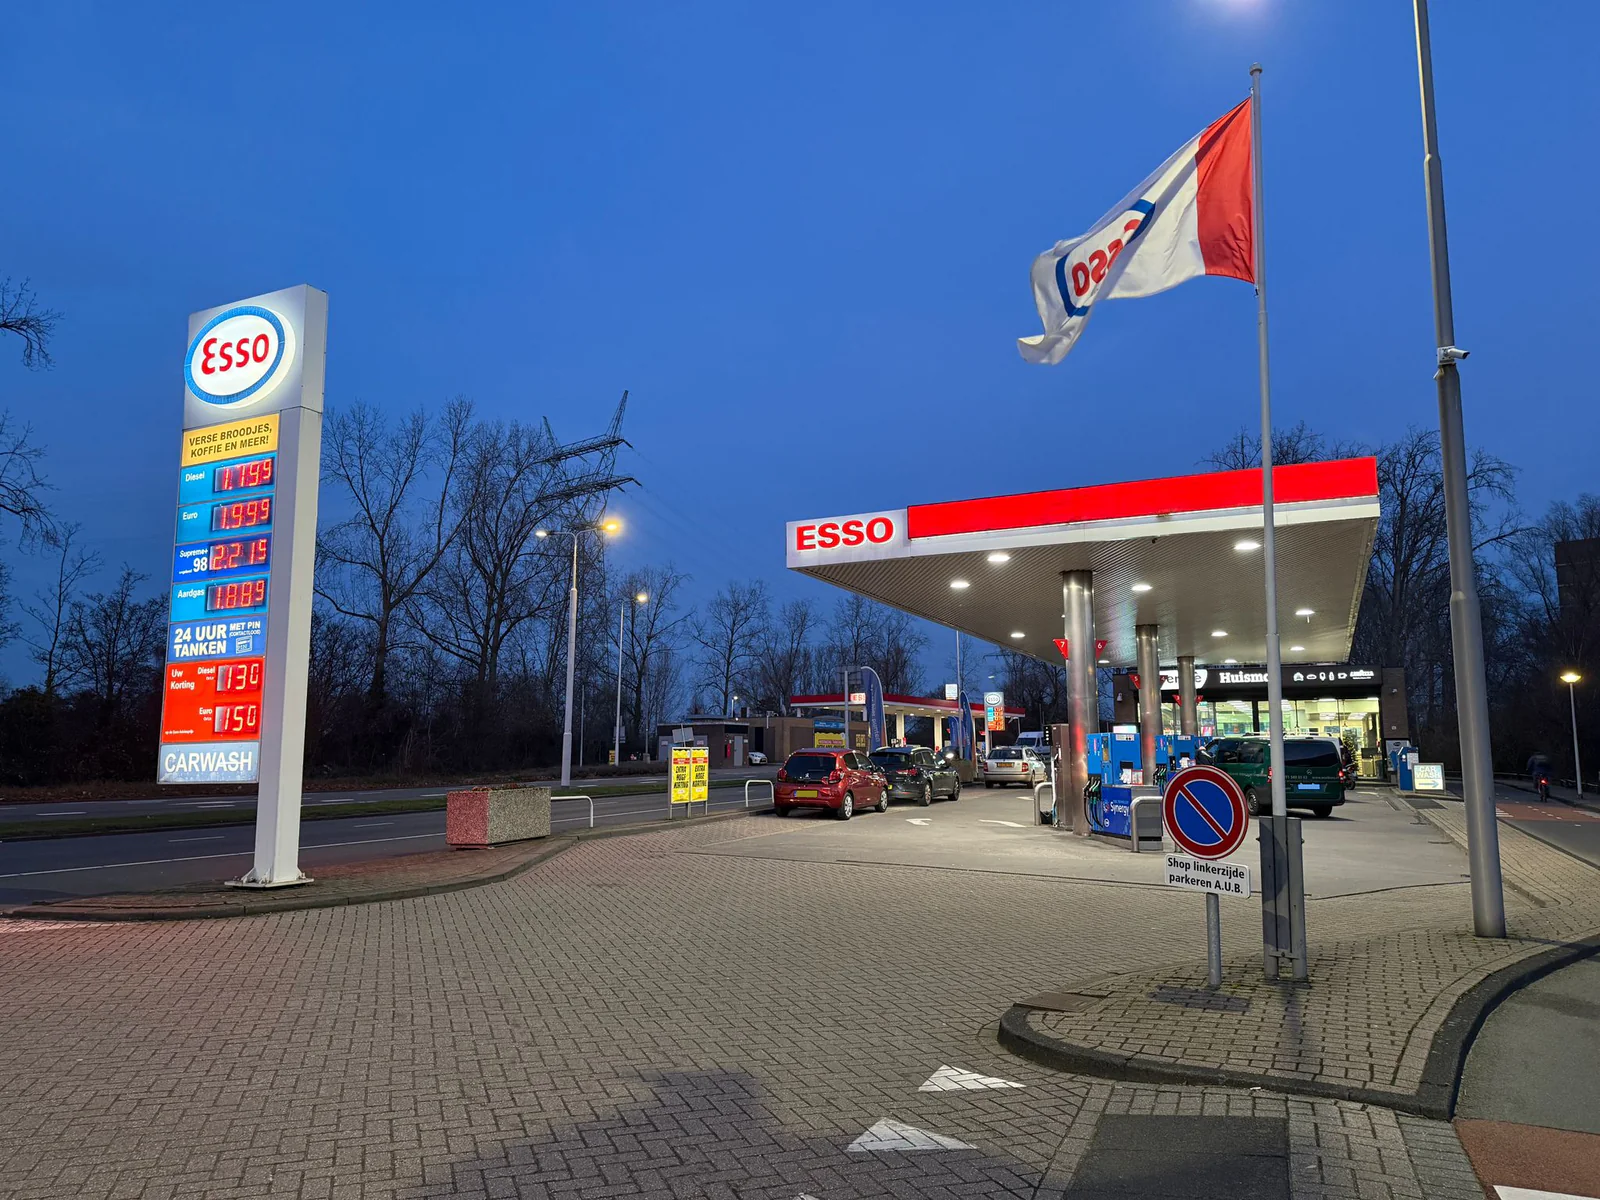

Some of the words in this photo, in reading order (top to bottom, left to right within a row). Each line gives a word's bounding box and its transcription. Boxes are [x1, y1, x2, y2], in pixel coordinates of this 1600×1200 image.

[189, 433, 218, 447] VERSE
[220, 423, 272, 441] BROODJES,
[191, 444, 222, 458] KOFFIE
[225, 441, 237, 451] EN
[240, 435, 269, 450] MEER!
[185, 471, 205, 482] Diesel
[182, 511, 198, 520] Euro
[796, 517, 894, 551] ESSO
[193, 556, 208, 573] 98
[177, 588, 205, 599] Aardgas
[174, 627, 192, 643] 24
[195, 624, 227, 642] UUR
[230, 623, 246, 632] MET
[247, 620, 261, 629] PIN
[173, 640, 227, 657] TANKEN
[171, 669, 183, 678] Uw
[197, 666, 215, 675] Diesel
[170, 681, 195, 691] Korting
[199, 707, 213, 715] Euro
[165, 751, 253, 773] CARWASH
[1110, 801, 1130, 816] Synergy
[1167, 857, 1191, 871] Shop
[1193, 861, 1245, 880] linkerzijde
[1169, 873, 1212, 888] parkeren
[1214, 880, 1244, 895] A.U.B.
